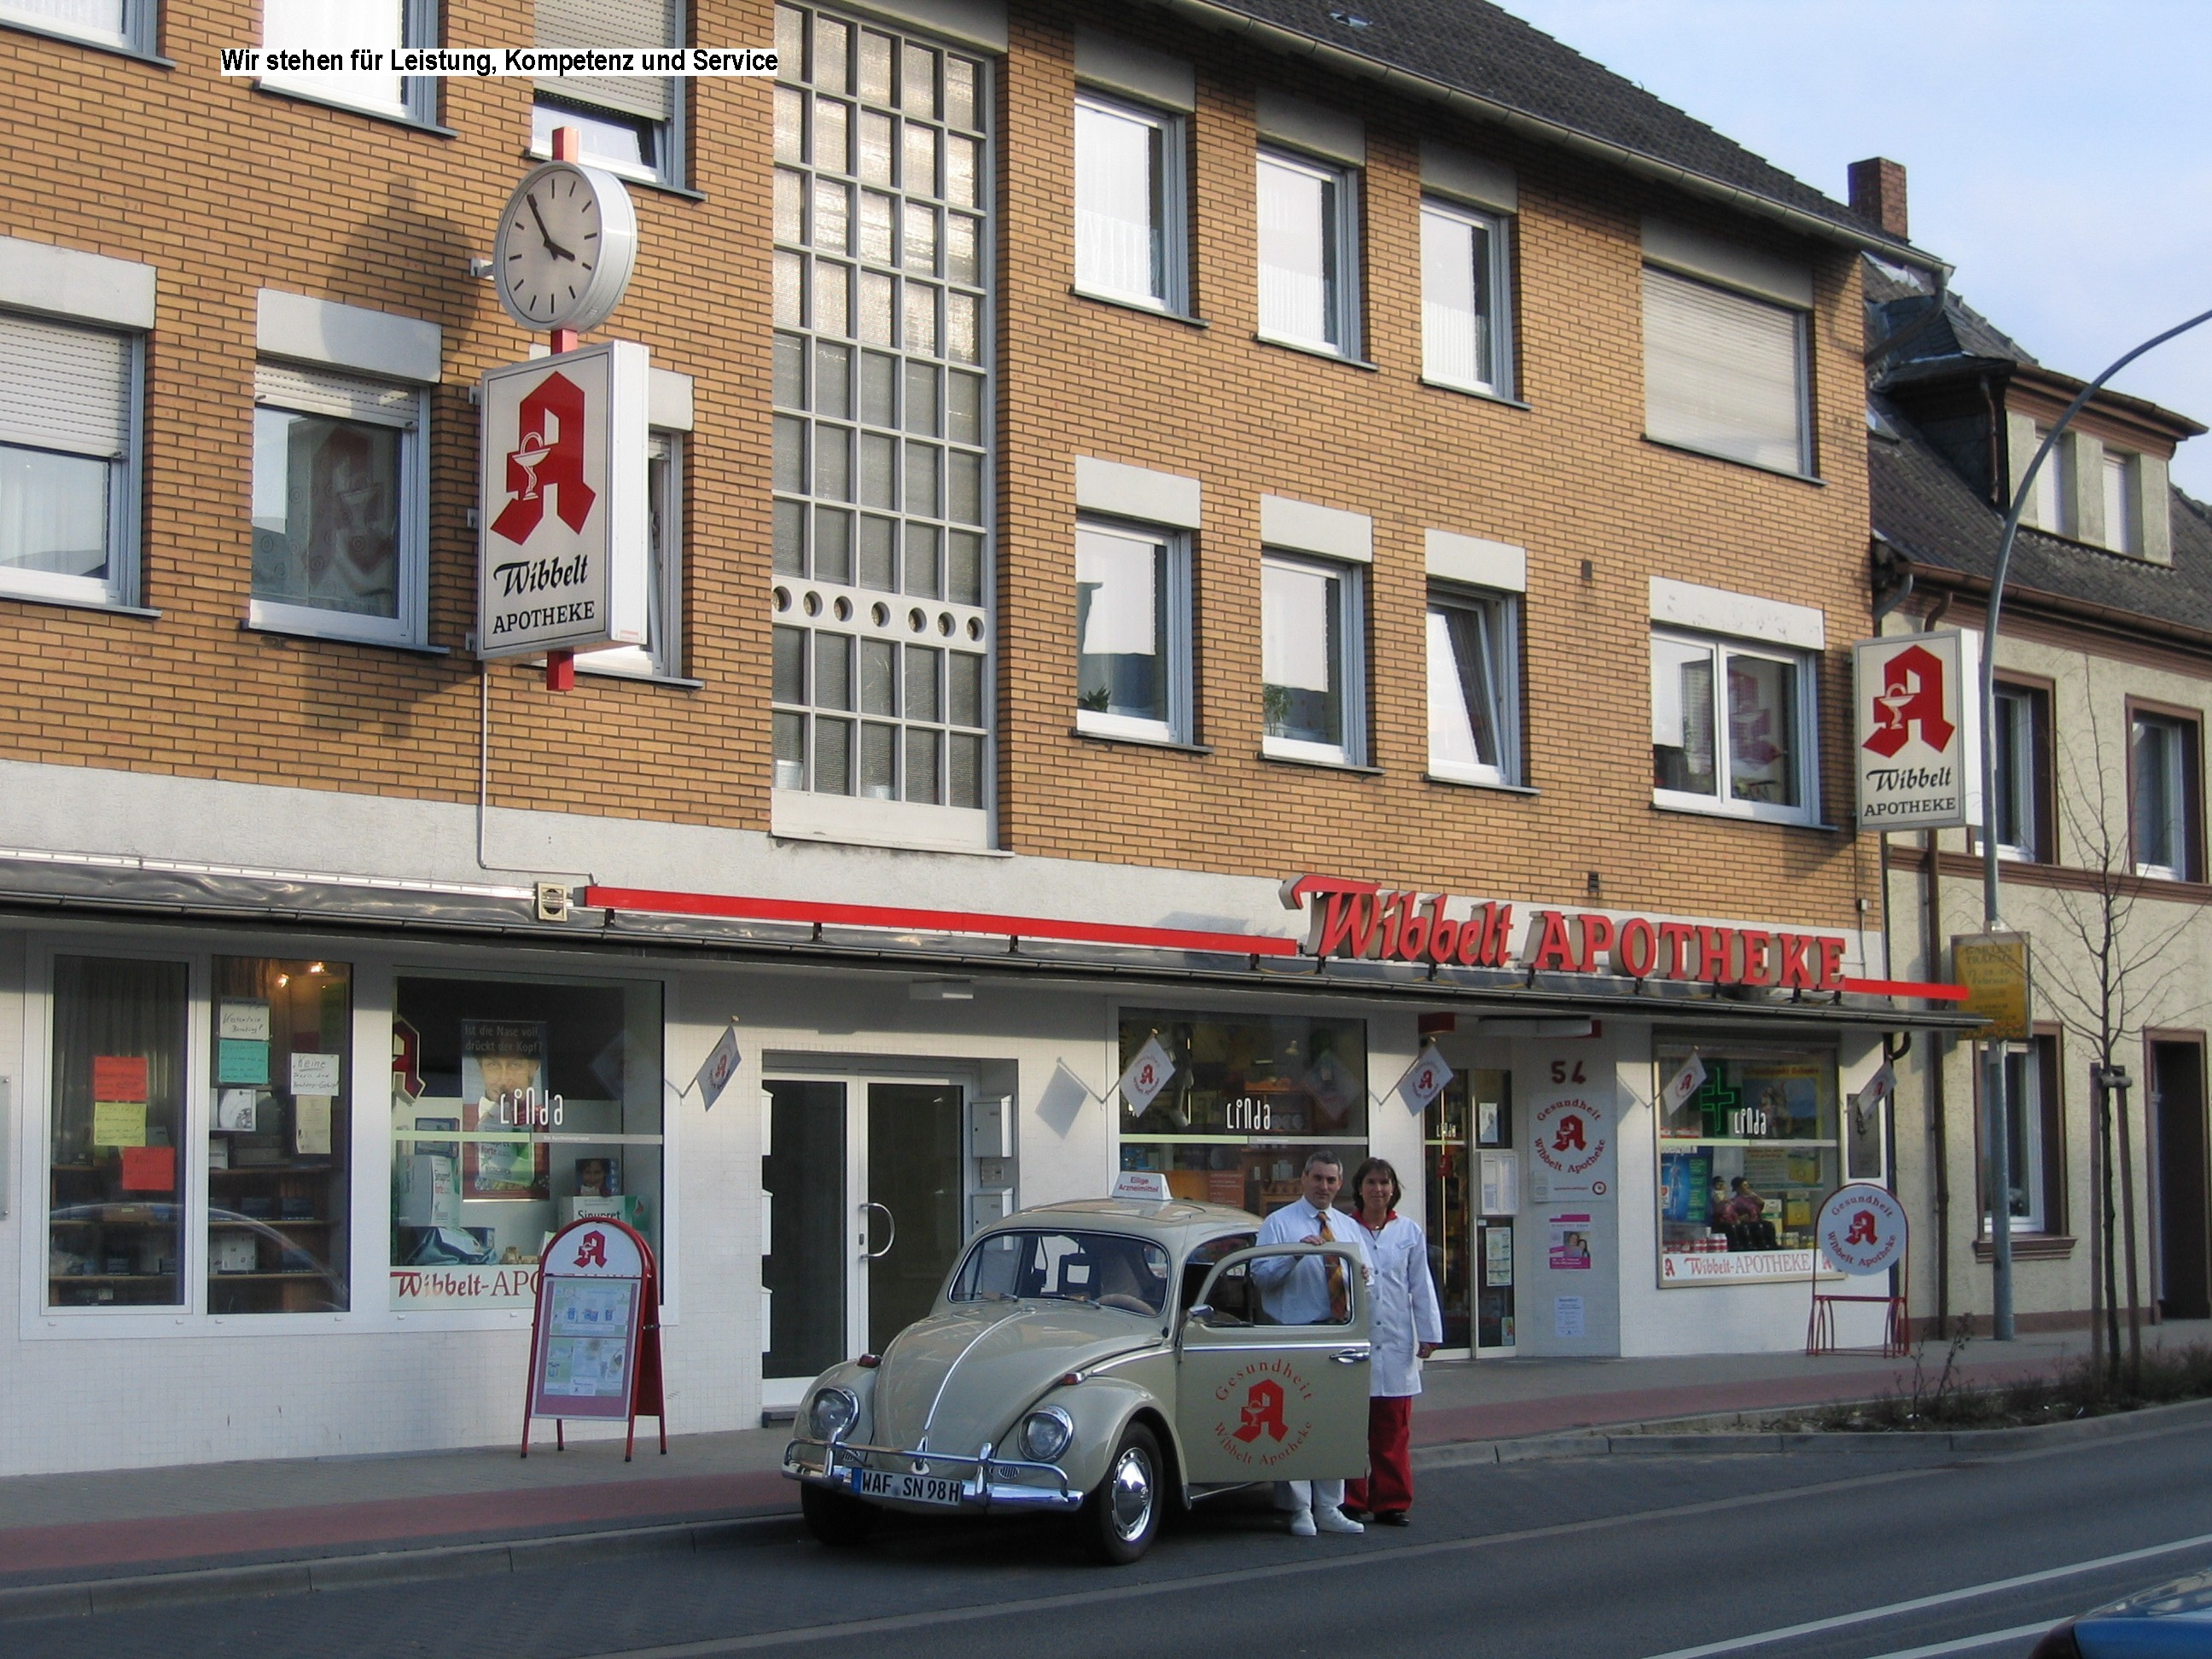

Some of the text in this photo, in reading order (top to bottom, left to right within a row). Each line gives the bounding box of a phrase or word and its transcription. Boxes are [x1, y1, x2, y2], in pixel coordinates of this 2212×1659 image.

[493, 554, 588, 597] Wibbelt
[492, 601, 595, 634] APOTHEKE
[1866, 766, 1952, 792] Wibbelt
[1864, 797, 1955, 817] APOTHEKE
[1280, 874, 1846, 991] Wibbelt APOTHEKE
[480, 1026, 493, 1035] die
[497, 1026, 518, 1036] Nase
[465, 1040, 543, 1055] drückt der Kopf?
[1537, 1098, 1602, 1121] Gesundheit
[1534, 1138, 1605, 1174] Wibbelt Apotheke
[1831, 1196, 1894, 1217] Gesundheit
[1827, 1231, 1895, 1267] Wibbelt Apotheke
[1215, 1359, 1312, 1400] Gesundheit
[1215, 1422, 1312, 1466] Wibbelt Apotheke
[862, 1472, 893, 1493] WAF
[903, 1477, 923, 1498] SN
